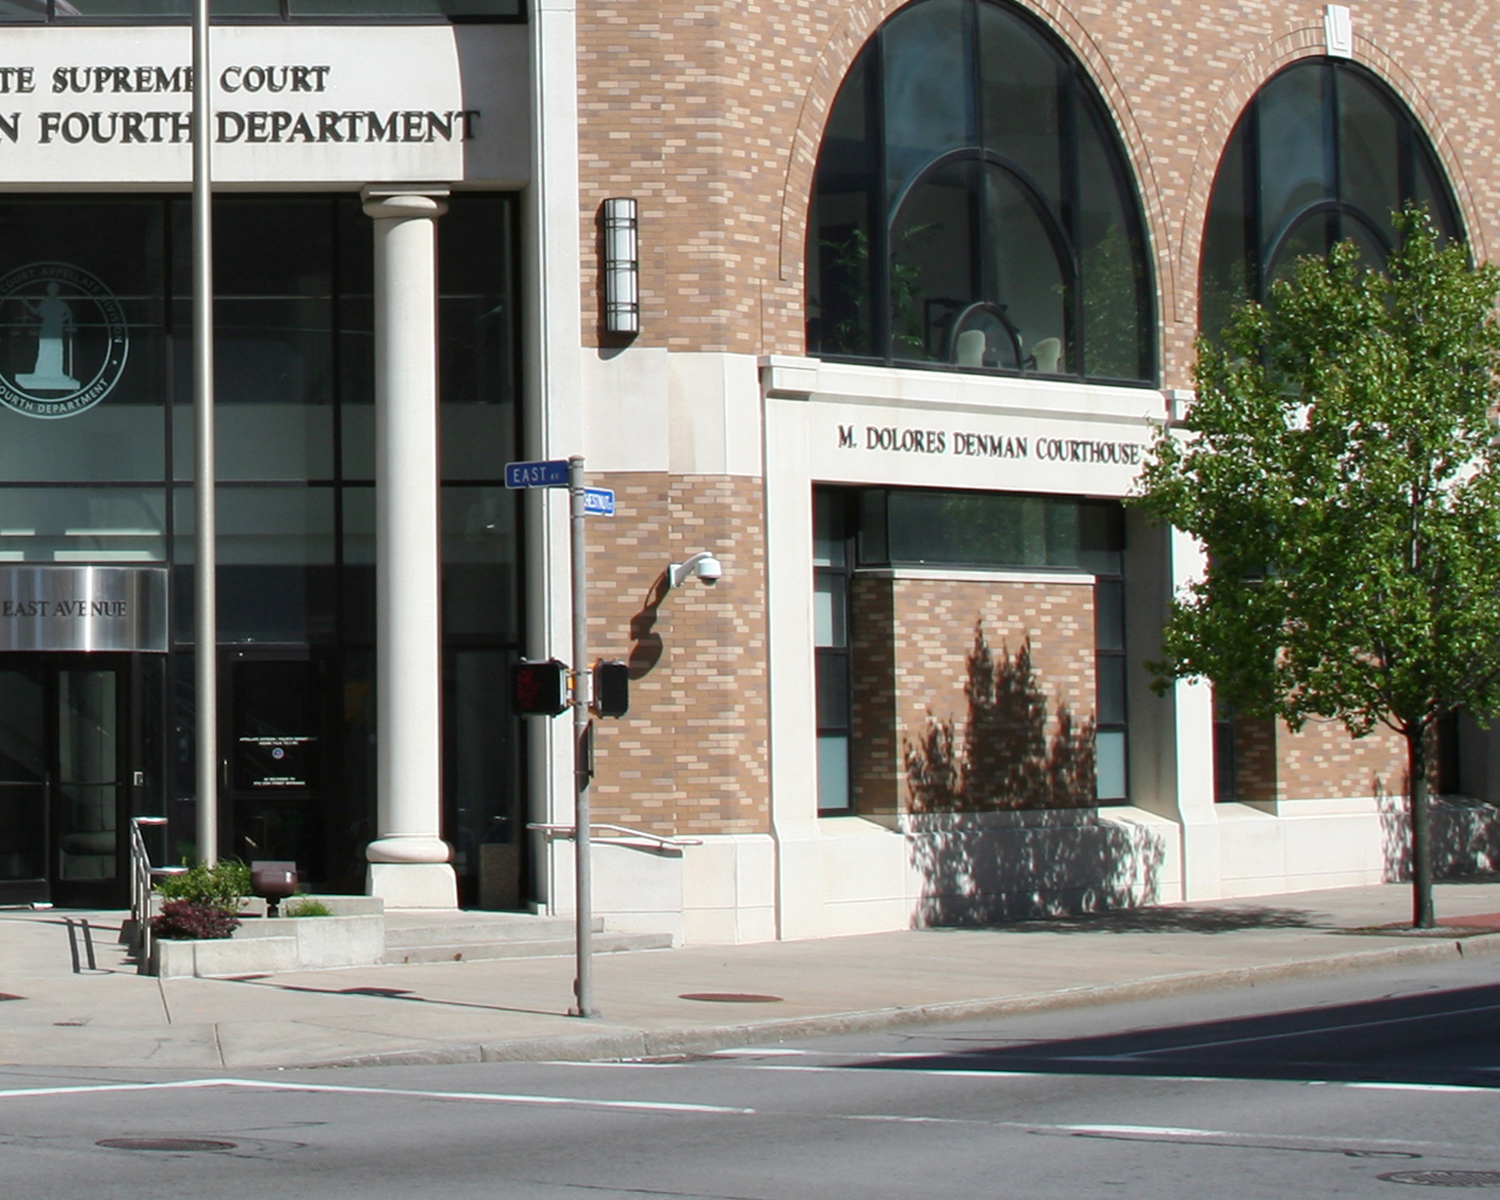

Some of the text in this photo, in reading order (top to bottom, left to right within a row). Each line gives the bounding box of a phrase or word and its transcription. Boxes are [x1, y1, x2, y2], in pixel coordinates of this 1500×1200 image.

[52, 65, 193, 94] SUPREME
[219, 65, 330, 93] COURT
[38, 111, 193, 144] FOURTH
[214, 110, 480, 144] DEPARTMENT
[37, 378, 109, 414] DEPARTMENT
[837, 424, 1141, 466] M. DOLORES DENMAN COURTHOUSE
[513, 466, 547, 483] EAST
[2, 601, 51, 617] EAST
[53, 601, 127, 617] AVENUE
